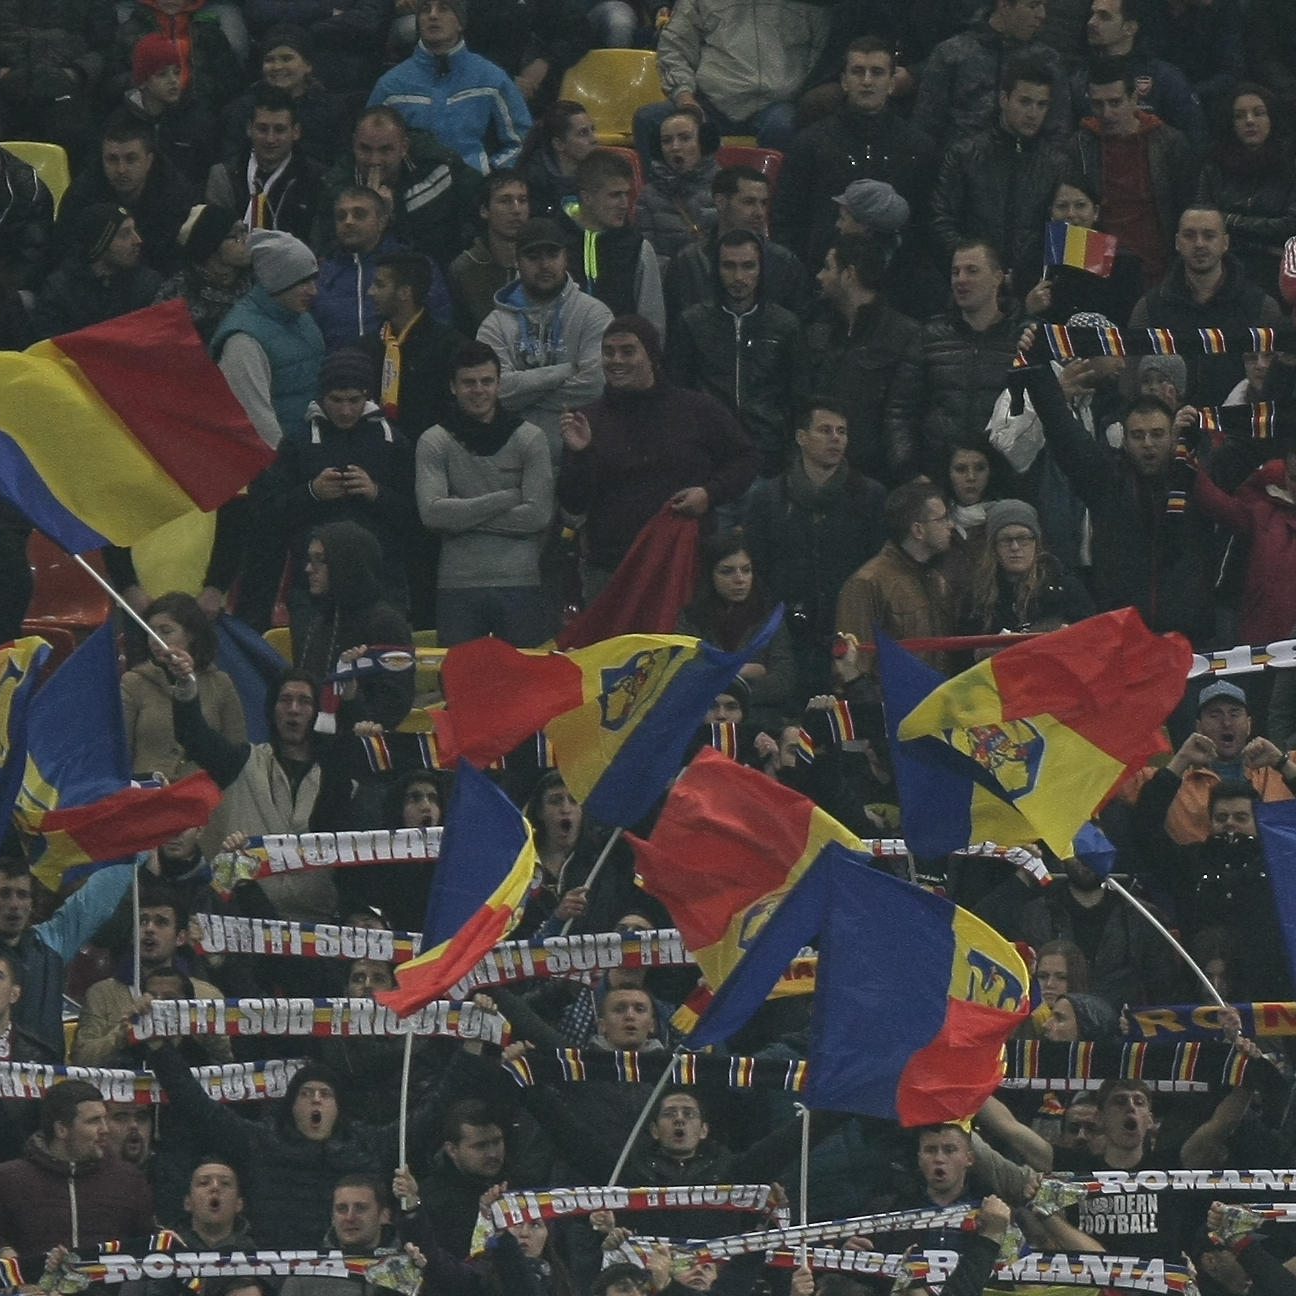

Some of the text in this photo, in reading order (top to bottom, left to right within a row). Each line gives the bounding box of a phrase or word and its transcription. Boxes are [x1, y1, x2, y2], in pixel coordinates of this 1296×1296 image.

[314, 922, 395, 961] SUB
[543, 933, 623, 973] SUB
[238, 998, 314, 1036] SUB
[99, 1250, 350, 1284] ROMANIA
[923, 1249, 1169, 1294] RMANIA
